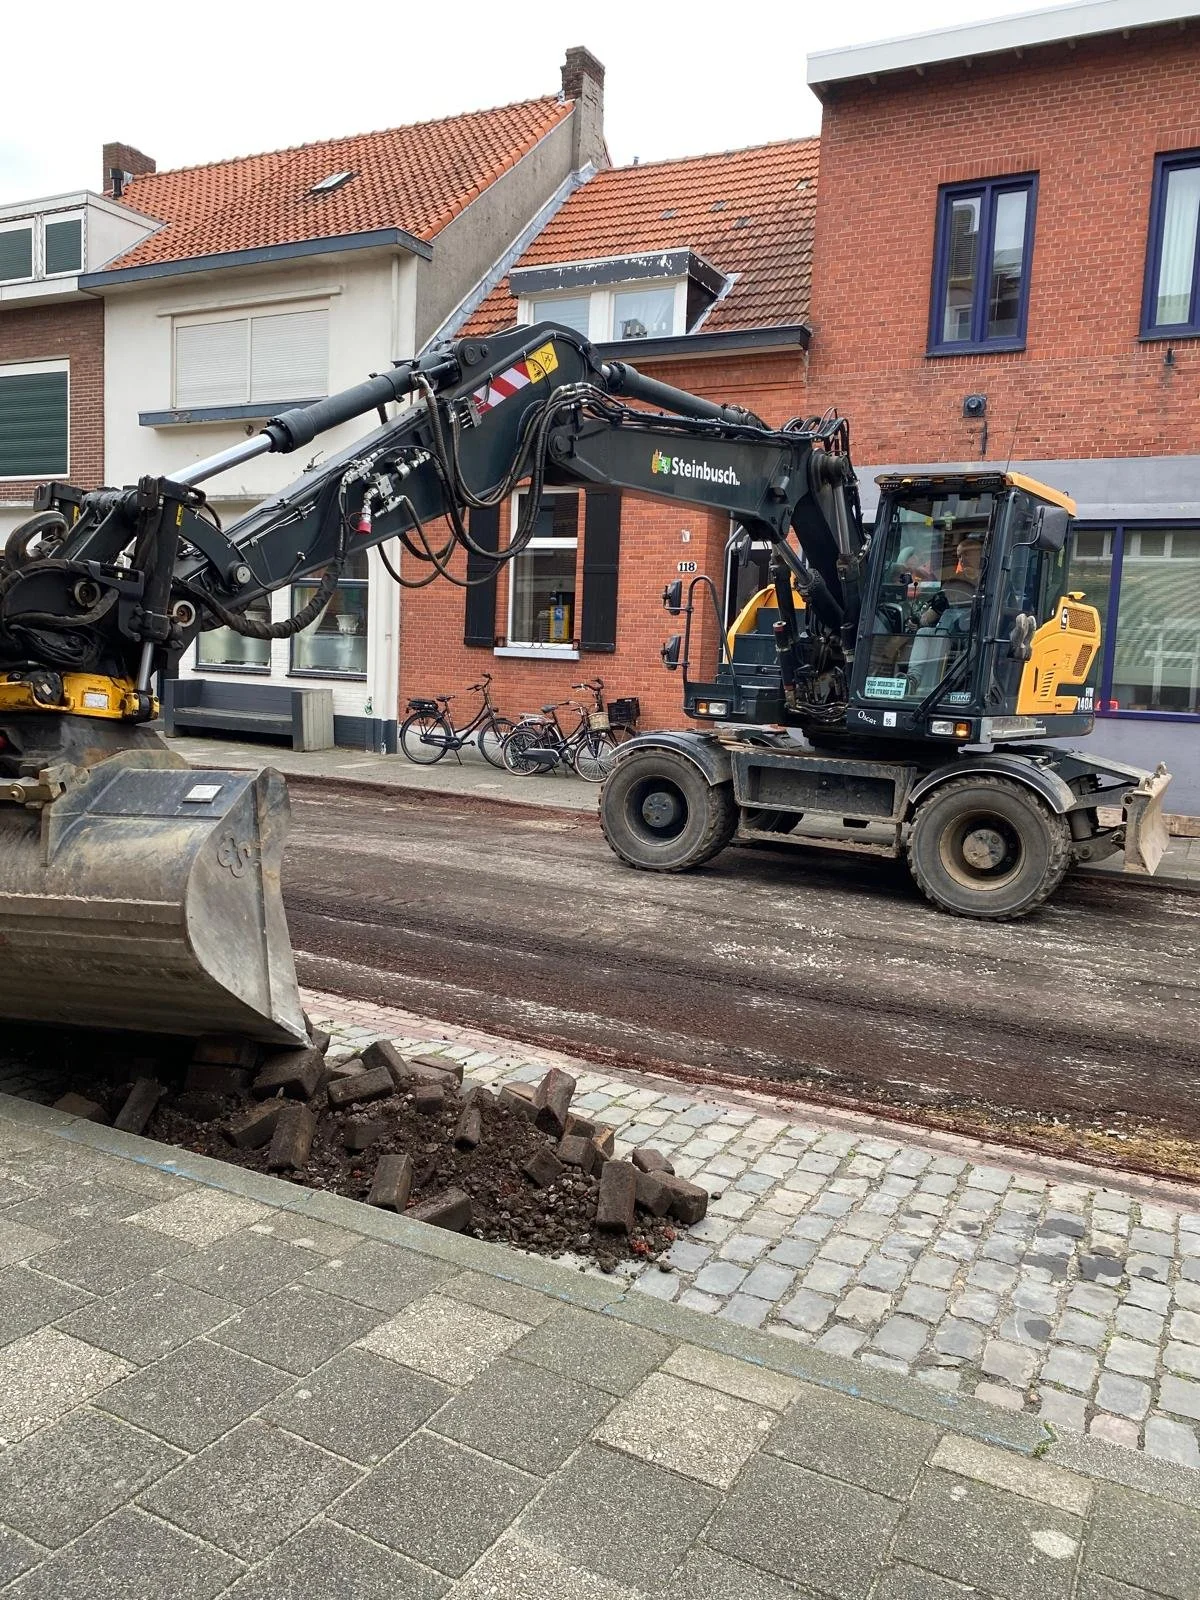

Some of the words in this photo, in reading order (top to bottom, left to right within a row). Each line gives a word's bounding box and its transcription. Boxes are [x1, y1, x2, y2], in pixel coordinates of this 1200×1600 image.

[671, 456, 736, 485] Steinbusch
[679, 561, 695, 572] 118
[1077, 697, 1093, 710] 140A
